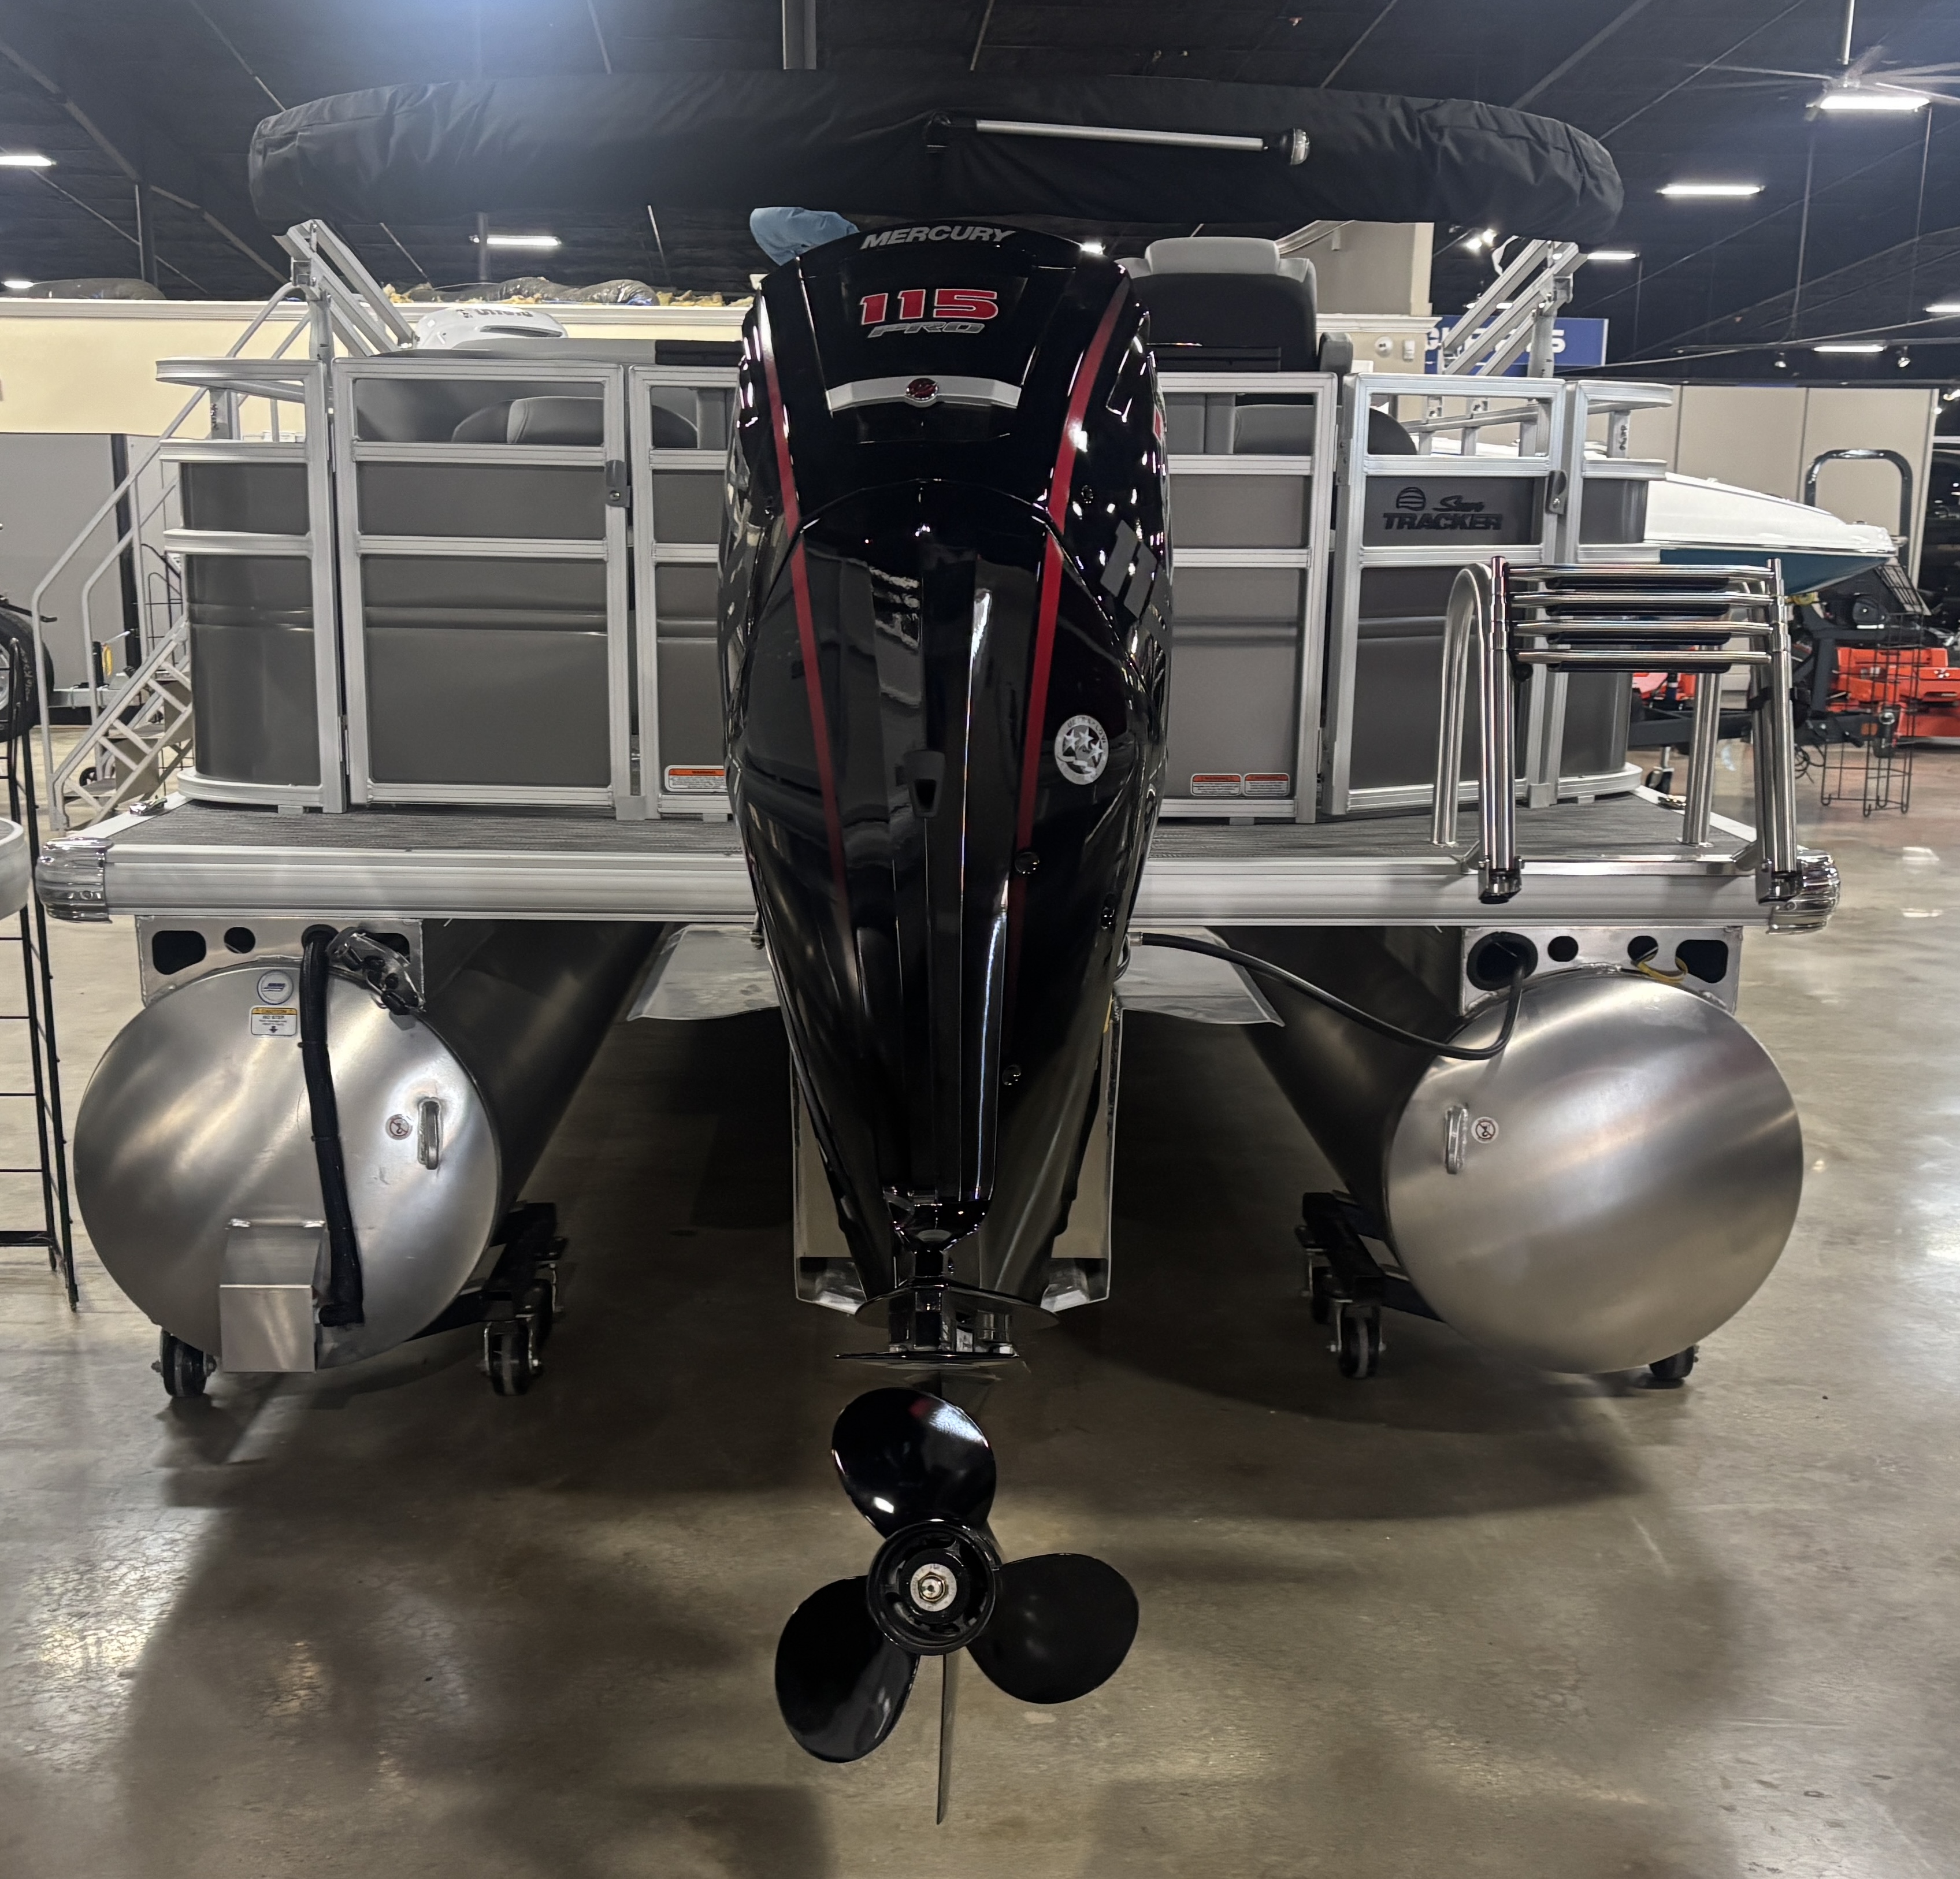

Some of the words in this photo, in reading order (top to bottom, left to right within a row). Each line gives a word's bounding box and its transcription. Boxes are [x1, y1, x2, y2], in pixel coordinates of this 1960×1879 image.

[860, 225, 1016, 250] MERCURY
[859, 288, 998, 325] 115
[867, 321, 985, 339] PRO
[1383, 513, 1502, 530] TRACKER
